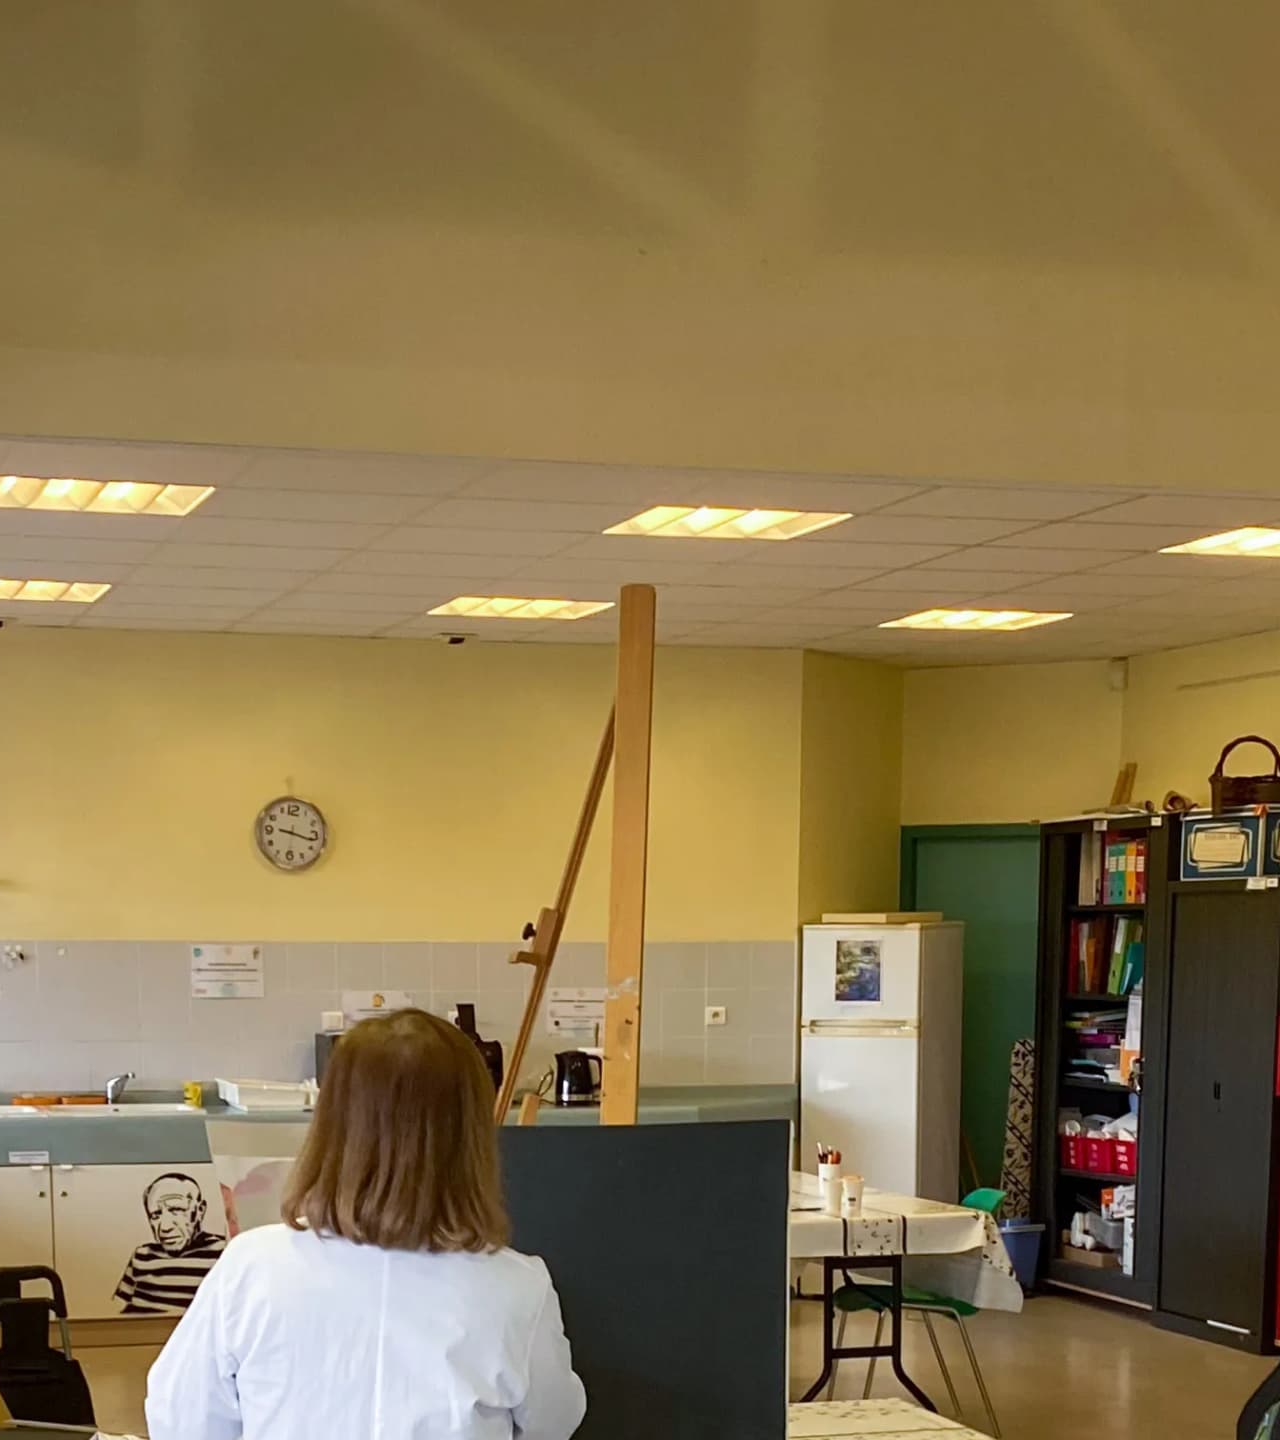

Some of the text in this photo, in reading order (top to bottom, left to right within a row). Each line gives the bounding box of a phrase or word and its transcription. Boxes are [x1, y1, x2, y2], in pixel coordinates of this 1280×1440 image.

[288, 804, 300, 816] 12
[265, 825, 274, 835] 9
[286, 850, 294, 861] 6
